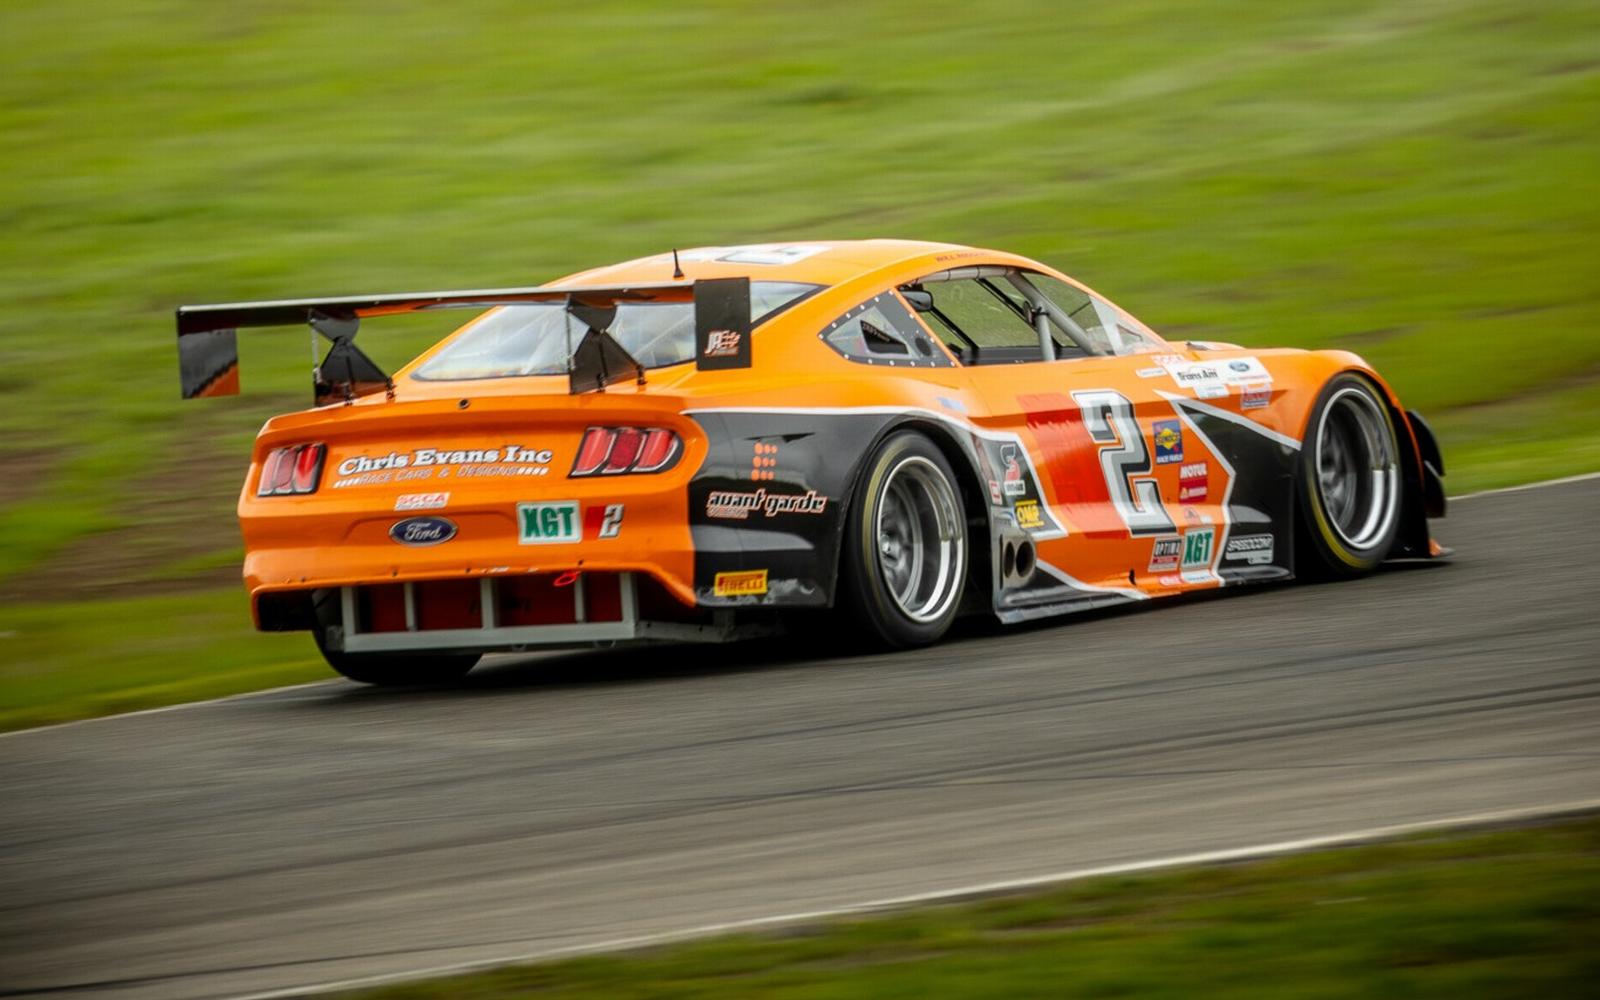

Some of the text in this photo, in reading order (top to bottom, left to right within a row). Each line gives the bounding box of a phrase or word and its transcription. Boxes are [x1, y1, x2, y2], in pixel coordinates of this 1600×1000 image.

[1202, 369, 1218, 379] Am
[338, 445, 553, 476] Chris Evans Inc
[1070, 388, 1178, 538] 2
[438, 467, 451, 478] &
[1180, 462, 1208, 480] MOTUL
[397, 492, 447, 504] SCCA
[764, 490, 828, 517] garde
[522, 502, 625, 539] XGT 2
[1016, 504, 1040, 523] OMP
[403, 521, 443, 542] Ford
[1183, 532, 1213, 565] XGT
[718, 574, 764, 592] PIRELLI
